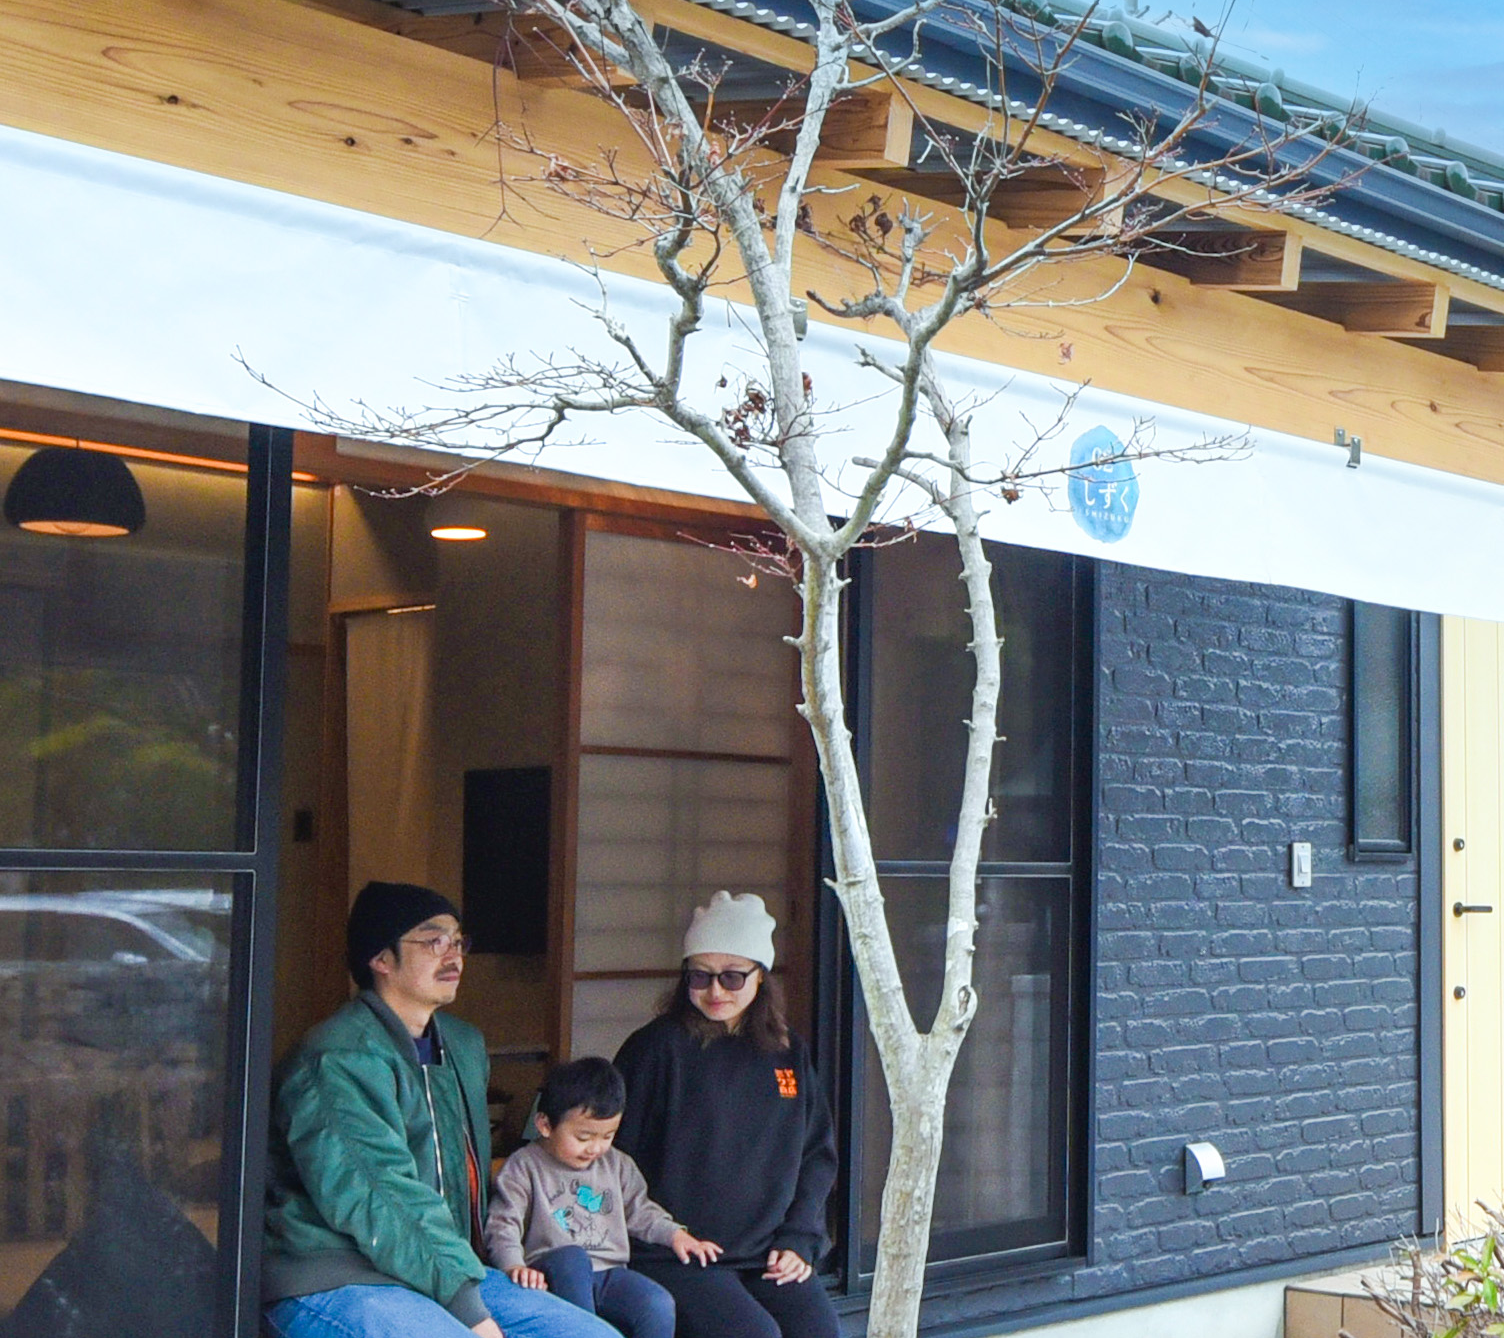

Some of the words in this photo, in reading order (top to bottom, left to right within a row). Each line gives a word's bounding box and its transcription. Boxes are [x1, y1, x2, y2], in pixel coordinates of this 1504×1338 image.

[1084, 480, 1130, 514] しずく
[1085, 508, 1130, 524] SHIZUKU
